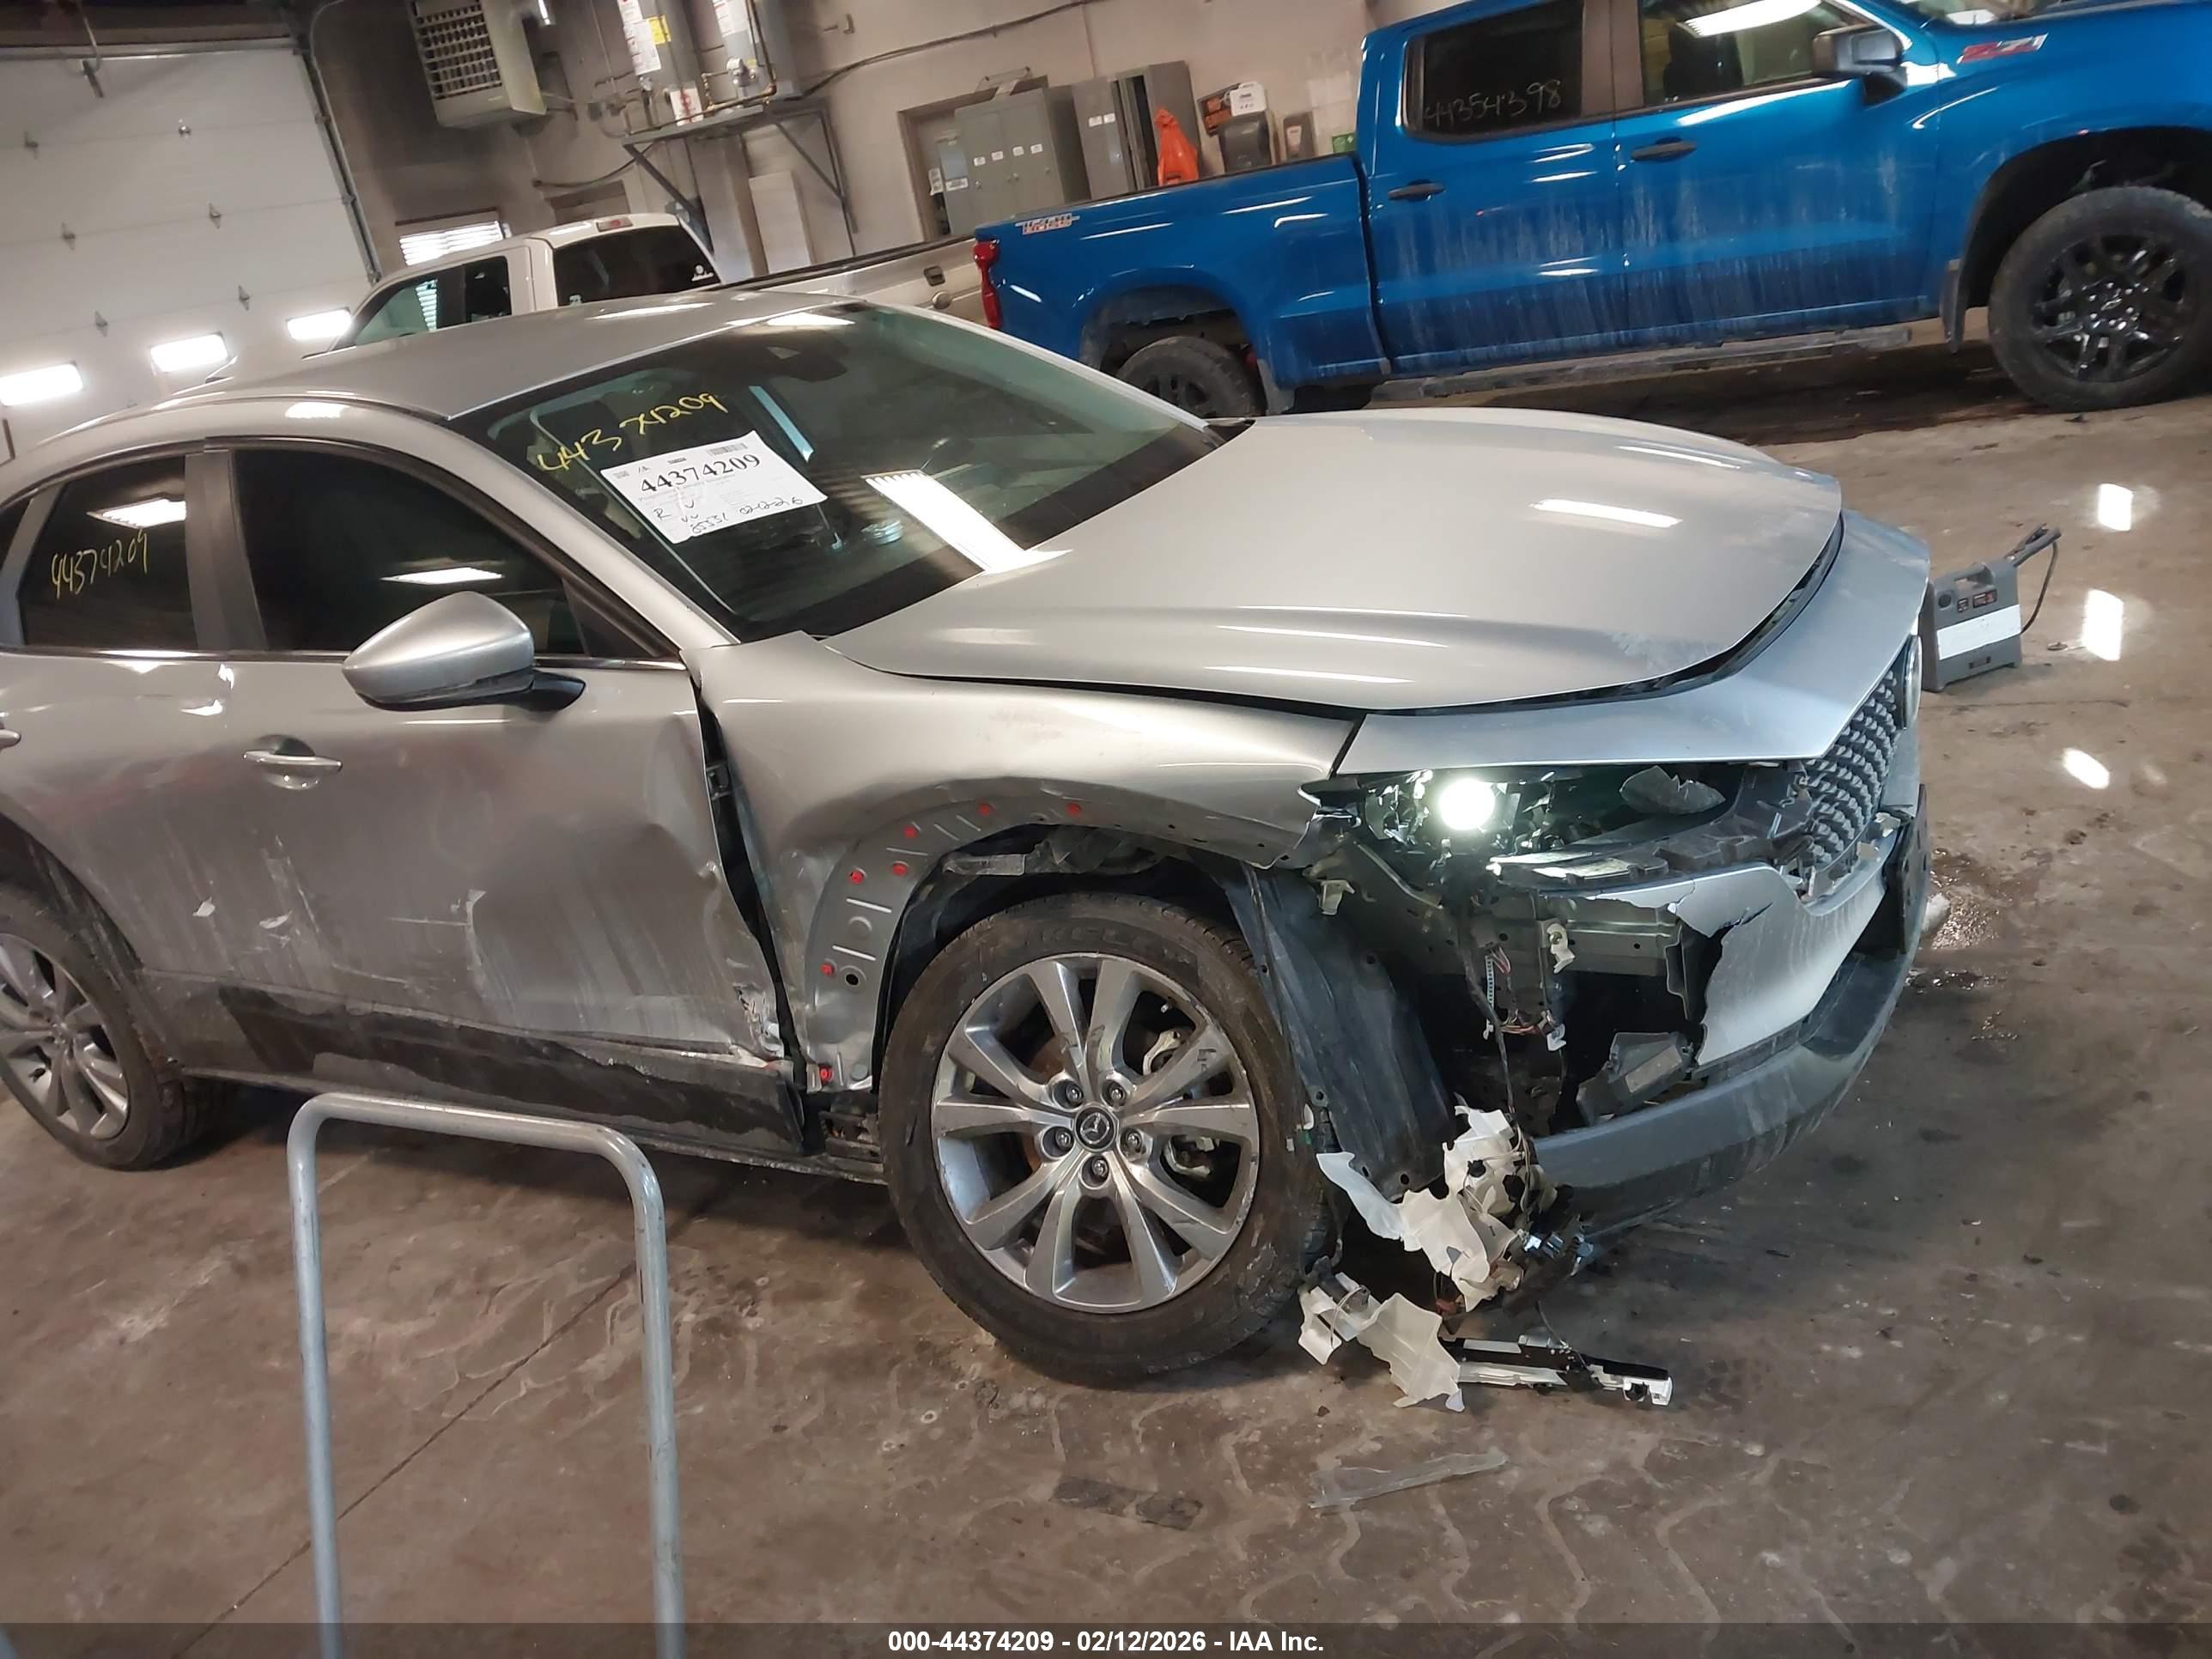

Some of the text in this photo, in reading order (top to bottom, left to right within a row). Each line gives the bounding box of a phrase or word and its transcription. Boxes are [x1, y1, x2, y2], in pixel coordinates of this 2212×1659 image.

[1424, 79, 1561, 127] 44354398
[641, 453, 761, 493] 44374209
[52, 528, 147, 599] 44374209
